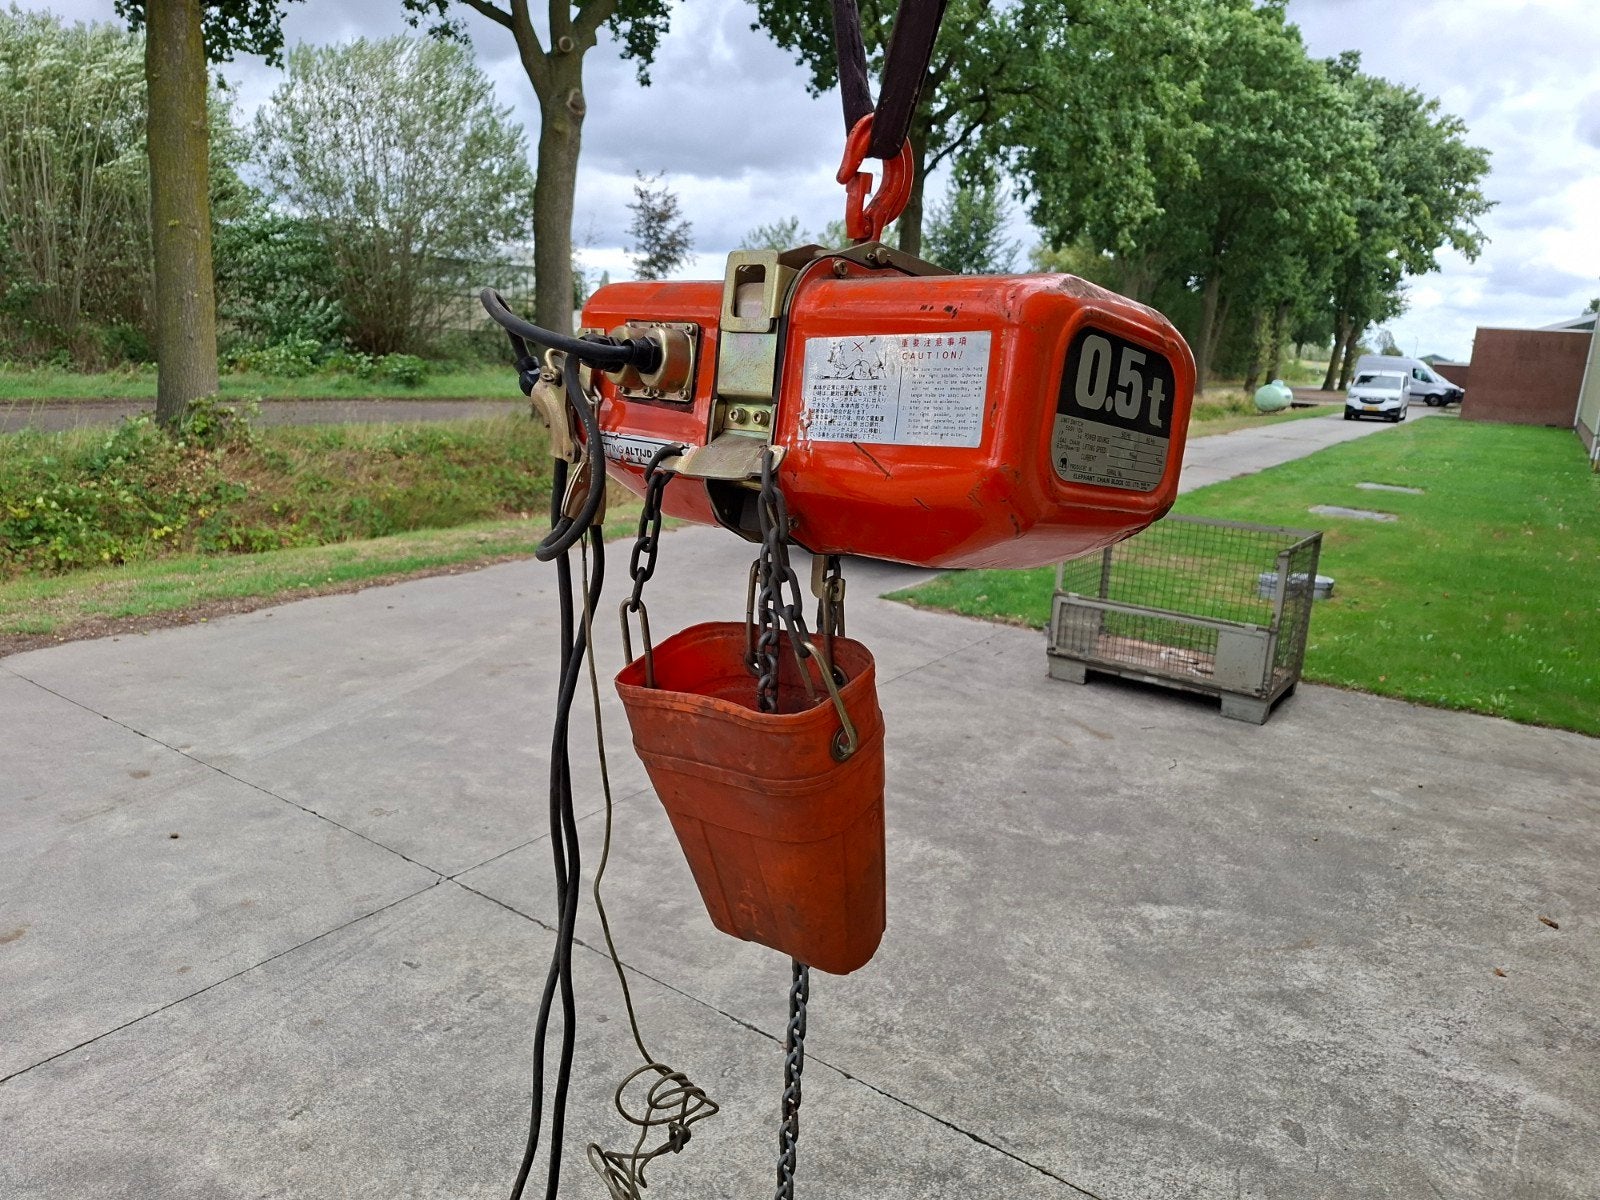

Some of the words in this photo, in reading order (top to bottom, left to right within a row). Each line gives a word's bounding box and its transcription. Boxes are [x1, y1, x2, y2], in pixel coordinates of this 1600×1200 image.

[901, 336, 967, 348] 重要注意事項
[902, 350, 963, 361] CAUTION!
[625, 446, 653, 458] ALTIJD
[1073, 472, 1095, 481] ELEPHANT
[1096, 476, 1110, 484] CHAIN
[1111, 478, 1124, 486] BLOCK
